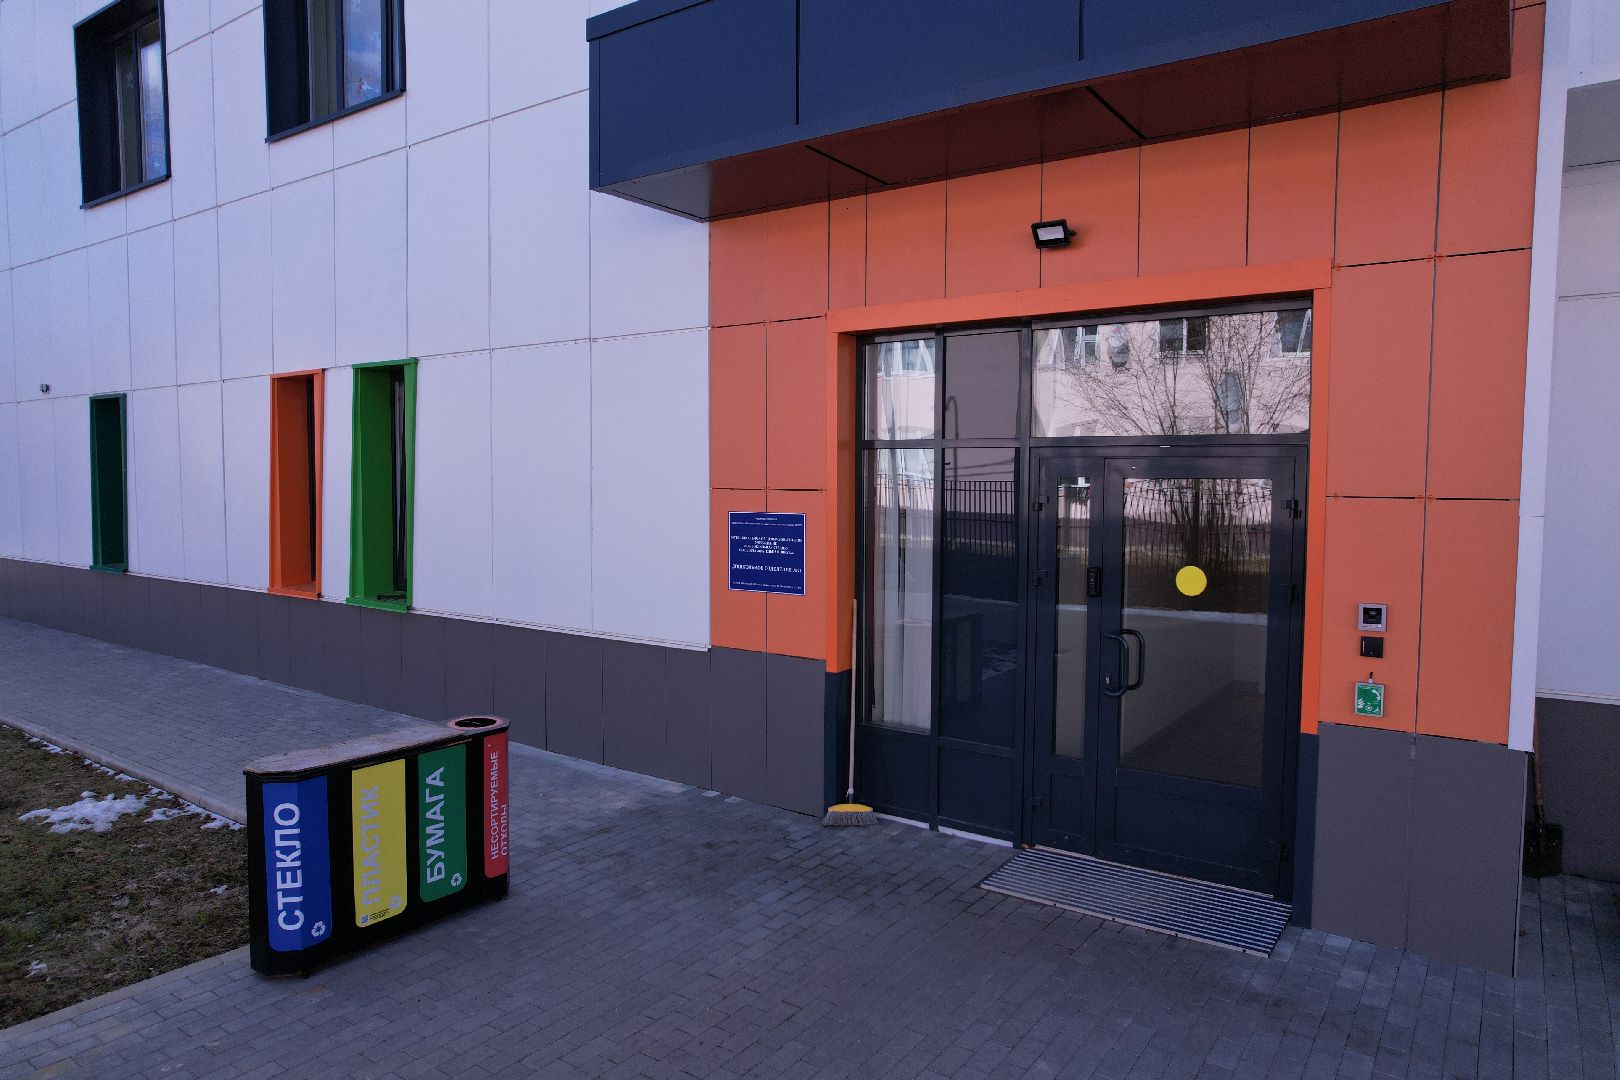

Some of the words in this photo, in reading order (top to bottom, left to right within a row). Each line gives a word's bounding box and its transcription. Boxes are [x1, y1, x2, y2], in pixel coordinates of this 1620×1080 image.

[360, 784, 382, 907] ПЛАСТИК
[425, 766, 446, 884] БУМАГА
[490, 751, 499, 860] НЕСОРТИРУЕМЫЕ
[273, 802, 305, 931] СТЕКЛО
